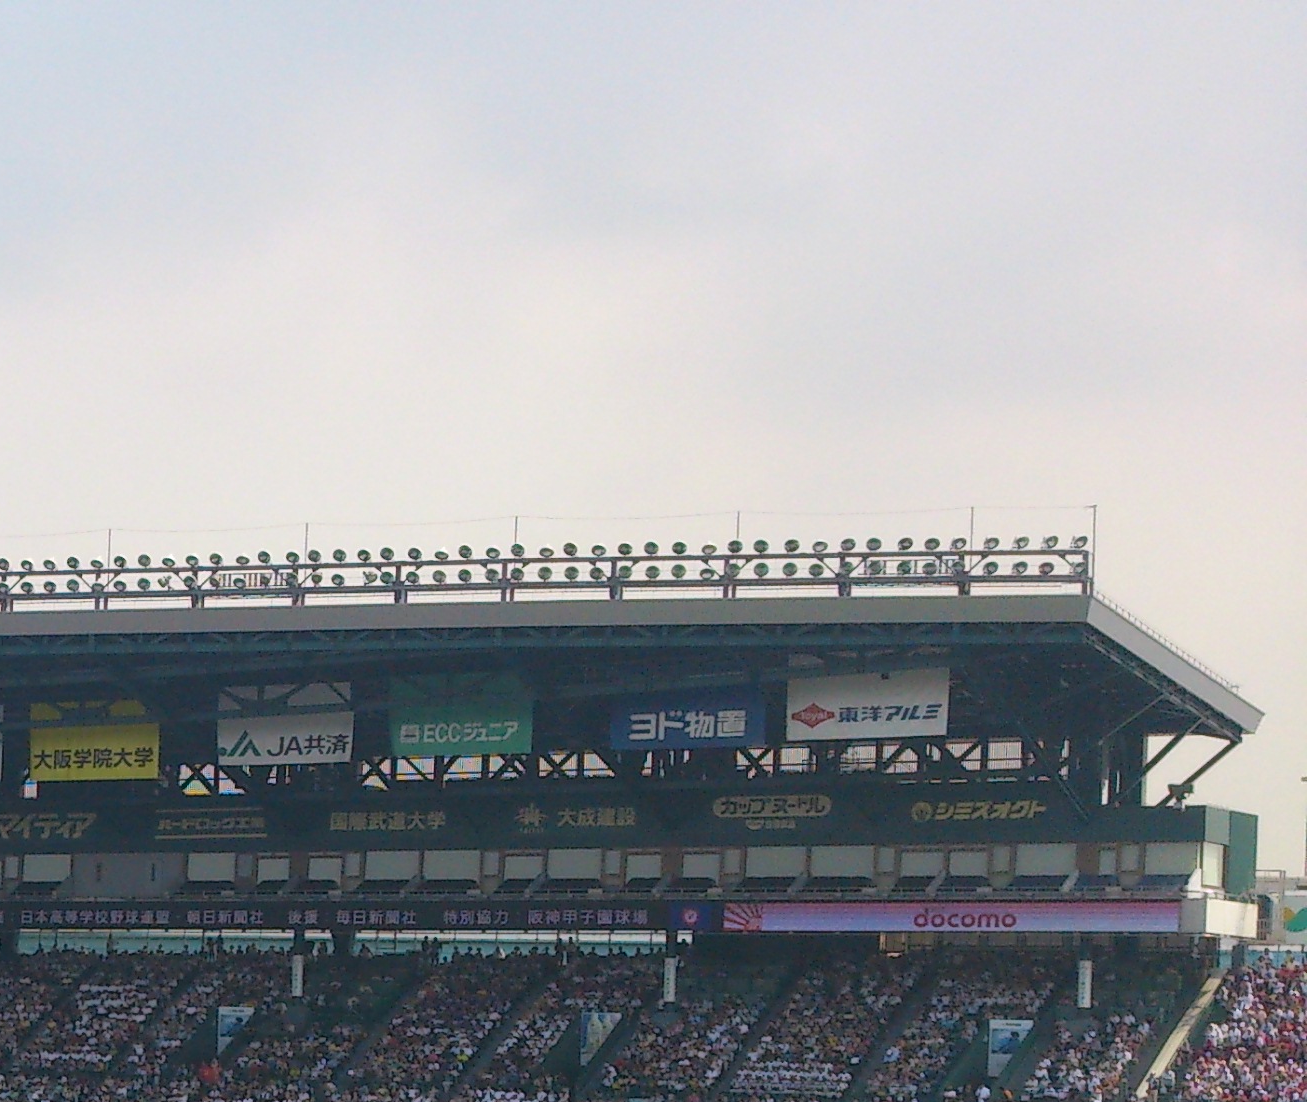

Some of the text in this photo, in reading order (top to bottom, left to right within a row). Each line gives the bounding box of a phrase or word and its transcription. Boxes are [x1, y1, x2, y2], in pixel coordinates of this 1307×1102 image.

[628, 708, 746, 741] ヨド物置
[837, 703, 942, 723] 東洋アルミ
[423, 721, 518, 744] ECCジュニア
[266, 733, 349, 757] JA共済
[33, 746, 154, 770] 大阪学院大学
[444, 911, 509, 926] 特別協力
[528, 910, 648, 927] 阪神甲子園球場
[913, 907, 1018, 929] docomo
